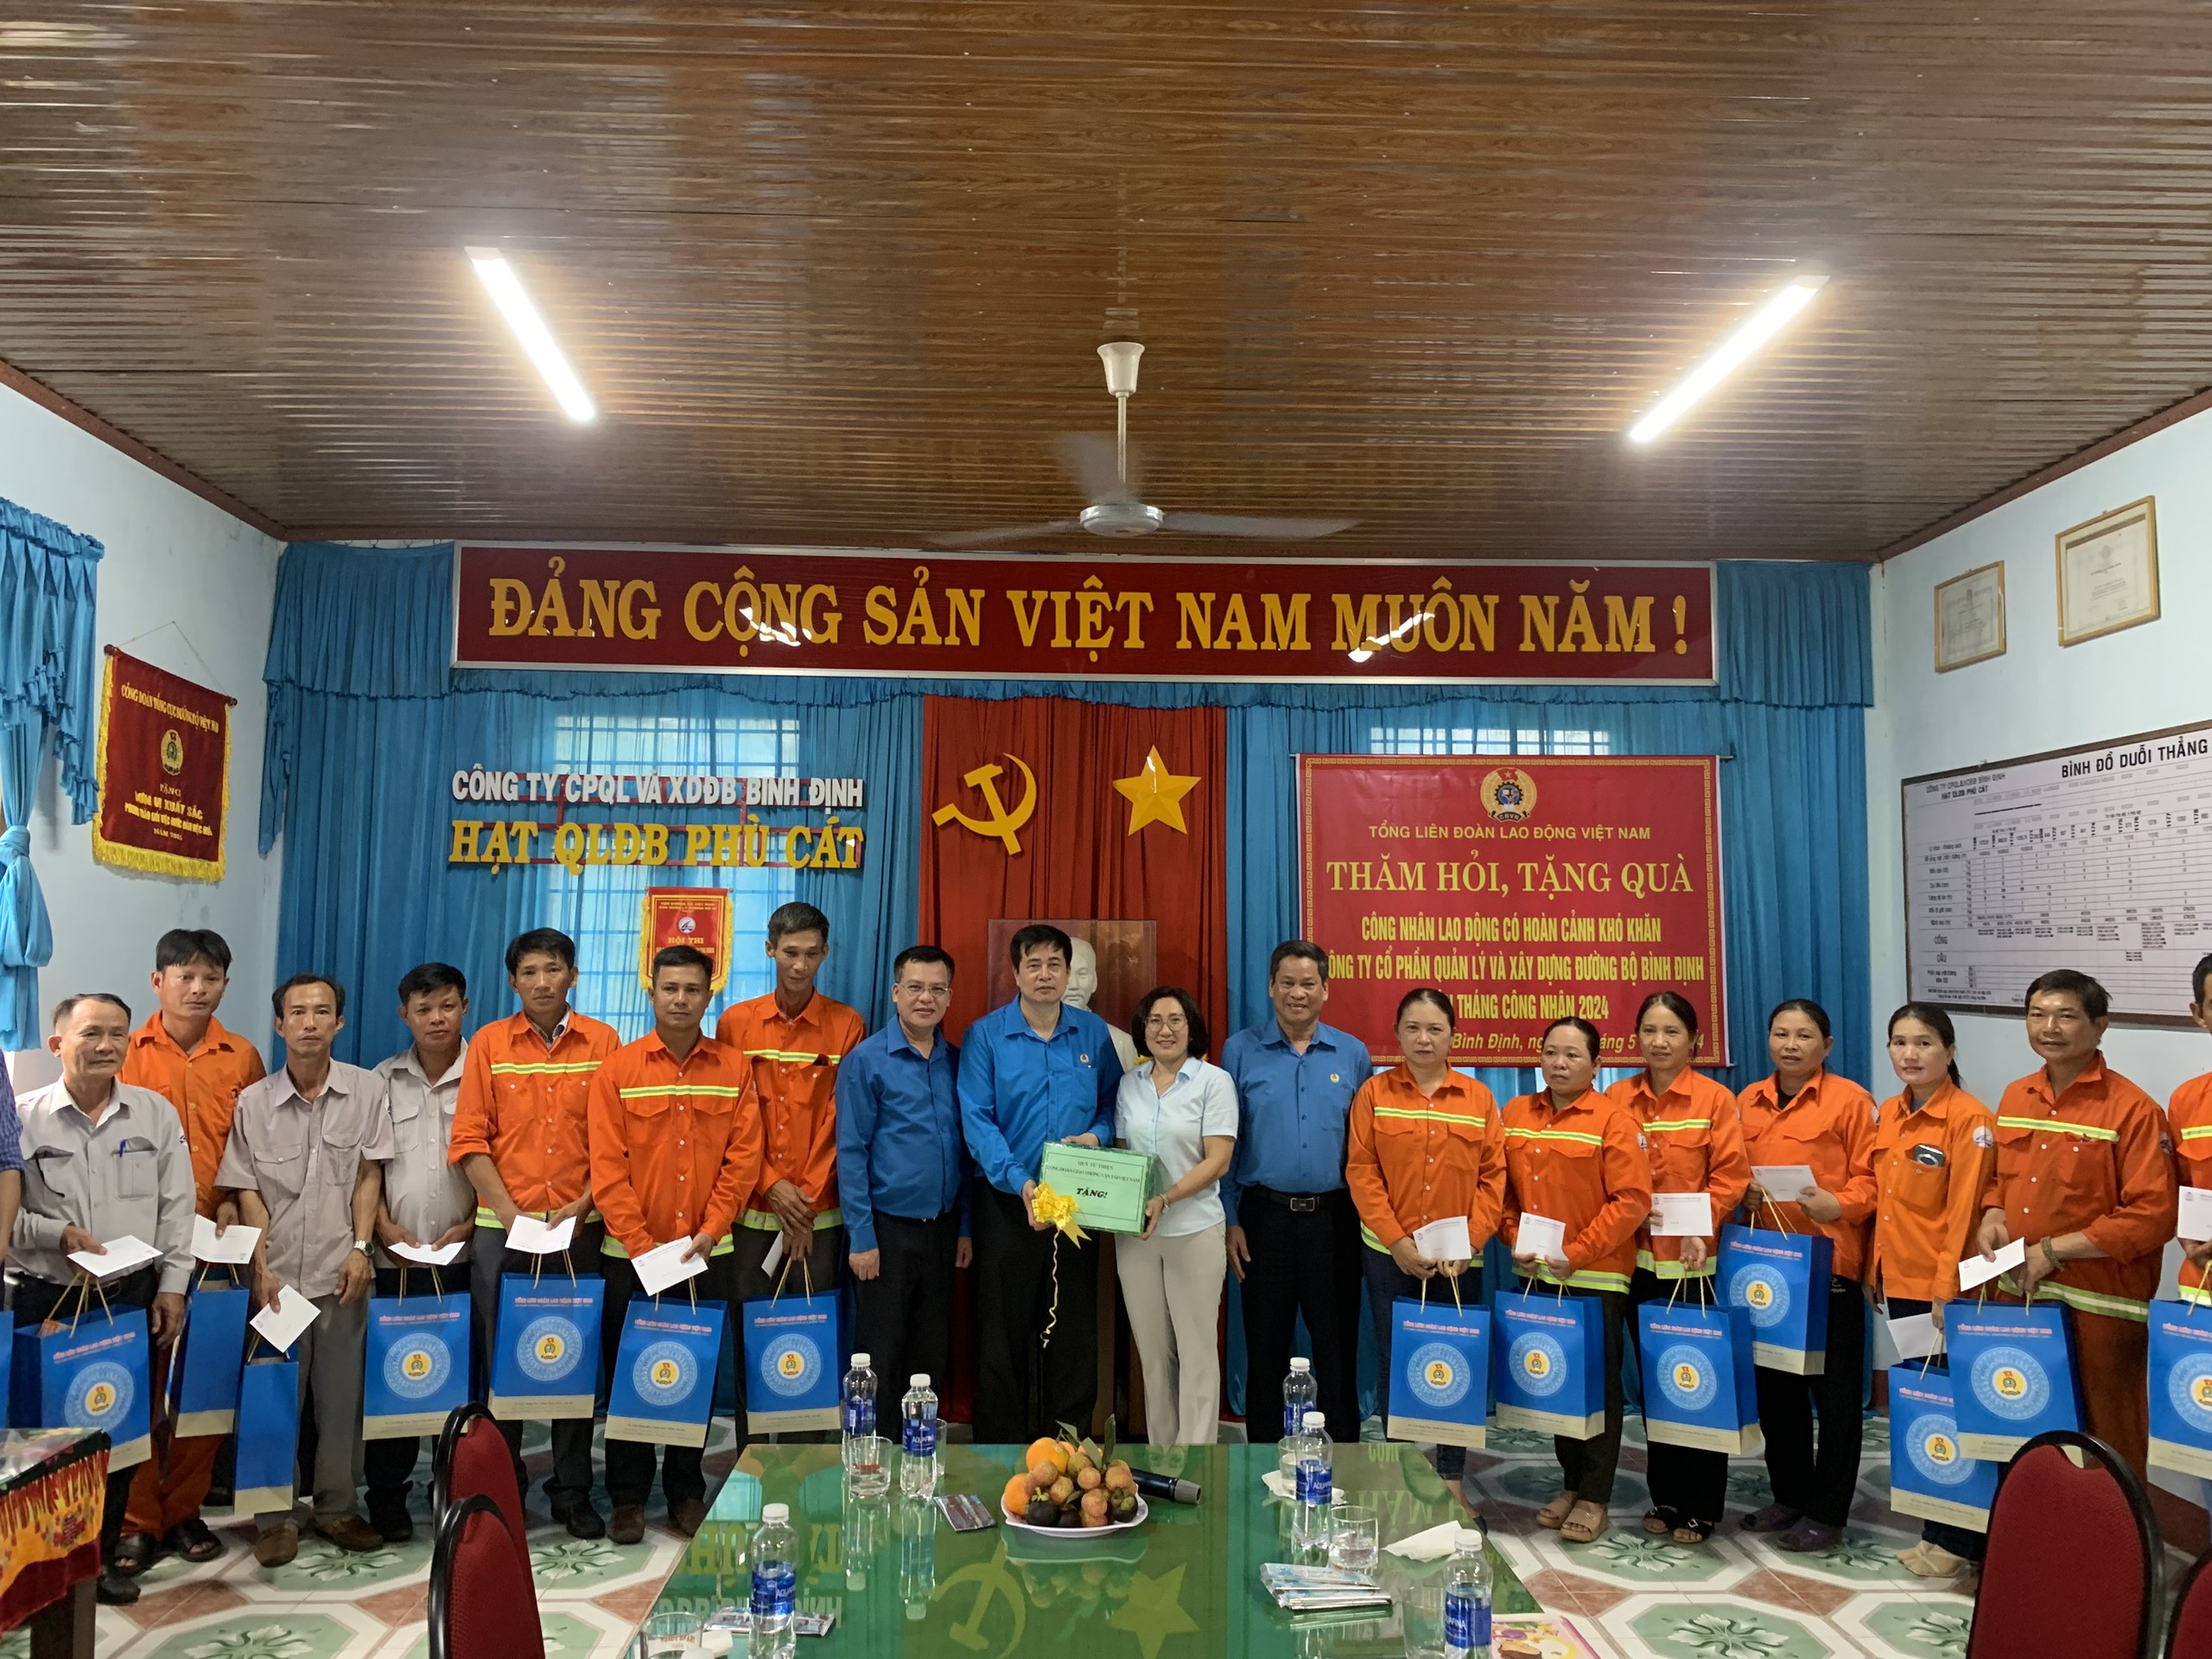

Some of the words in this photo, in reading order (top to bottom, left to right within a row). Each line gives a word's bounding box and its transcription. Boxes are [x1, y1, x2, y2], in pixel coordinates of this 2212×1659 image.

[488, 556, 662, 640] ĐẢNG
[683, 565, 842, 658] CỘNG
[864, 566, 986, 647] SẢN
[1007, 575, 1154, 663] VIỆT
[1176, 591, 1312, 651] NAM
[1332, 575, 1500, 654] MUÔN
[1519, 578, 1656, 653] NĂM
[2062, 760, 2091, 779] BÌNH
[2096, 751, 2114, 772] ĐỒ
[2120, 744, 2152, 768] DUỖI
[2158, 735, 2209, 761] THẲNG
[452, 763, 518, 802] CÔNG
[525, 772, 560, 802] TY
[564, 774, 631, 805] CPQL
[668, 775, 736, 805] XDĐB
[809, 778, 863, 815] ĐỊNH
[448, 819, 539, 875] HẠT
[555, 822, 669, 876] QLĐB
[683, 813, 770, 868] PHÙ
[785, 816, 864, 869] CÁT
[1369, 820, 1411, 838] TỔNG
[1414, 823, 1449, 838] LIÊN
[1453, 823, 1496, 839] ĐOÀN
[1500, 826, 1529, 839] LAO
[1533, 823, 1577, 842] ĐỘNG
[1580, 823, 1614, 842] VIỆT
[1618, 827, 1651, 840] NAM
[1326, 853, 1427, 892] THĂM
[1436, 849, 1510, 899] HỎI,
[1517, 855, 1612, 901] TẶNG
[1620, 853, 1694, 899] QUÀ
[1361, 911, 1396, 942] CÔNG
[1399, 912, 1435, 942] NHÂN
[1439, 916, 1462, 942] LAO
[1465, 912, 1500, 947] ĐỘNG
[1503, 912, 1521, 943] CÓ
[1523, 912, 1558, 943] HOÀN
[1560, 909, 1596, 943] CẢNH
[1599, 912, 1624, 943] KHÓ
[1626, 912, 1662, 943] KHĂN
[1327, 949, 1355, 980] ÔNG
[1357, 955, 1372, 980] TY
[1375, 944, 1393, 980] CỔ
[1395, 946, 1431, 981] PHẦN
[1433, 947, 1469, 983] QUẢN
[1471, 950, 1487, 981] LÝ
[1490, 950, 1507, 981] VÀ
[1510, 950, 1535, 981] XÂY
[1537, 953, 1573, 987] DỰNG
[1574, 950, 1618, 982] ĐƯỜNG
[1621, 950, 1638, 987] BỘ
[1642, 952, 1672, 982] BÌNH
[1675, 956, 1705, 987] ĐỊNH
[1458, 990, 1498, 1020] THÁNG
[1502, 990, 1536, 1020] CÔNG
[1540, 990, 1575, 1019] NHÂN
[1579, 995, 1610, 1020] 2024
[1452, 1033, 1484, 1049] Bình
[1488, 1033, 1523, 1053] Định,
[1599, 1033, 1624, 1053] áng
[1628, 1033, 1637, 1050] 5
[1076, 1187, 1108, 1199] TẶNG!
